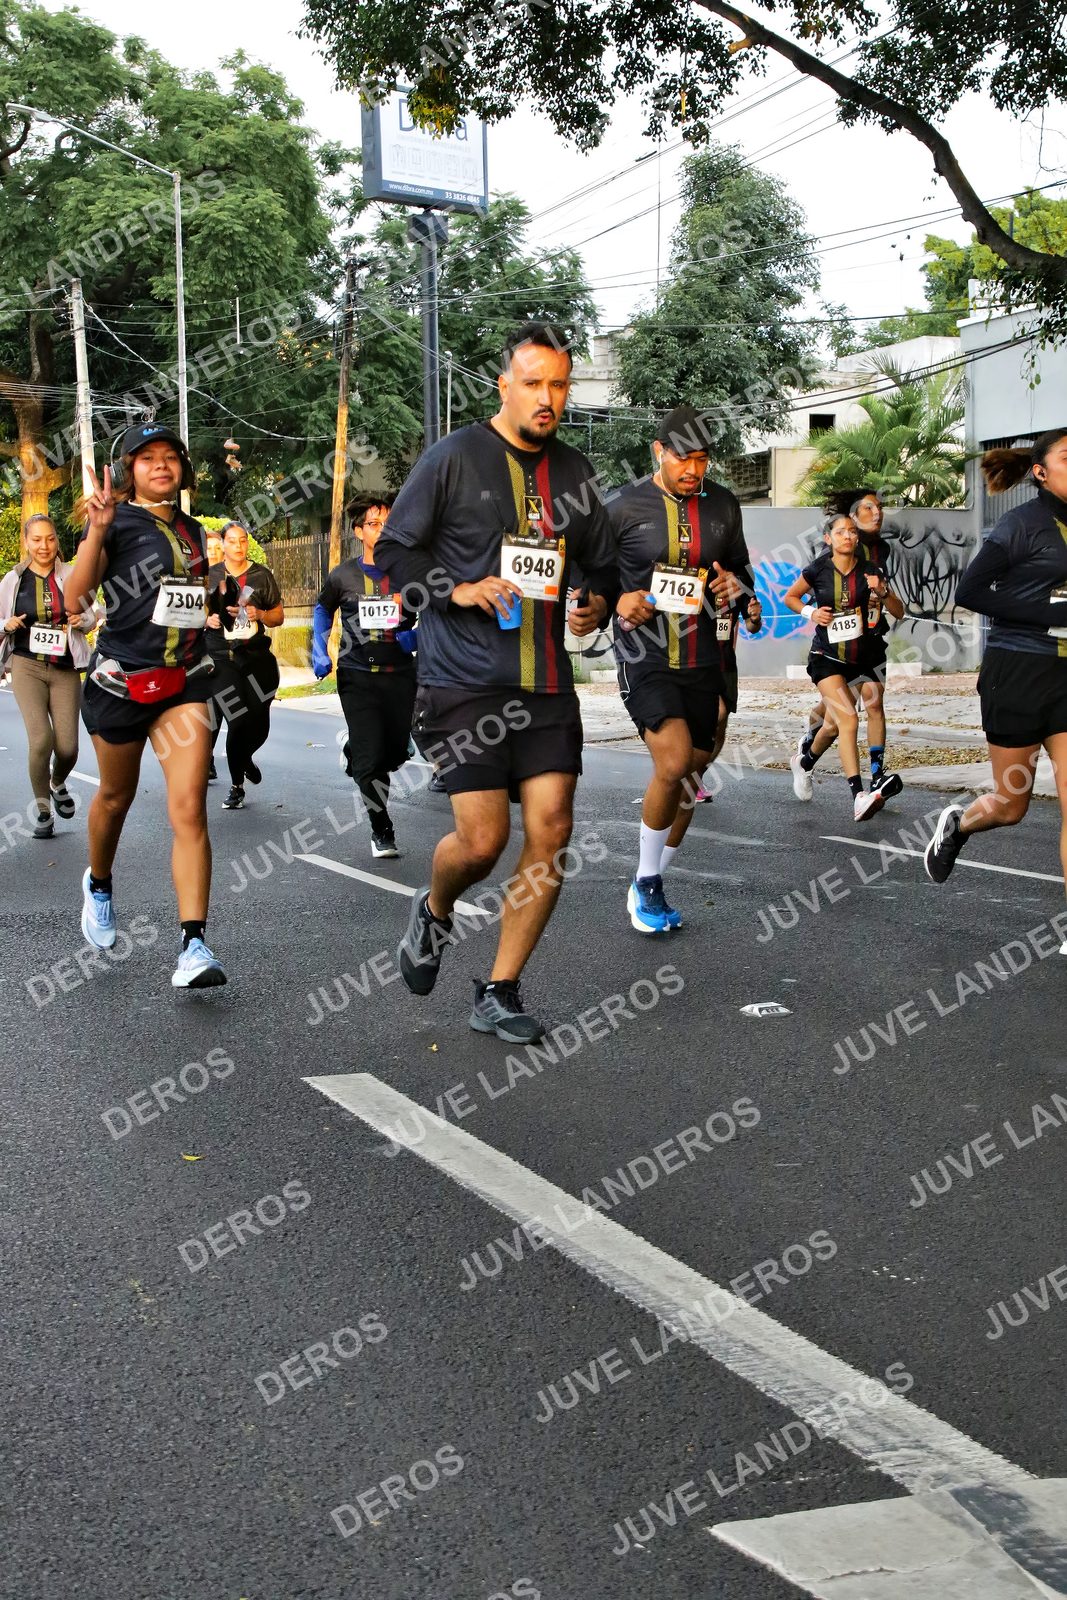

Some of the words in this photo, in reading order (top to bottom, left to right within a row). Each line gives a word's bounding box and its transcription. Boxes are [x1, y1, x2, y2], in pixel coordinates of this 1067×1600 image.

[512, 554, 555, 578] 6948
[659, 579, 695, 597] 7162
[166, 592, 204, 611] 7304
[361, 605, 396, 617] 10157
[832, 618, 857, 632] 4185
[34, 632, 60, 644] 4321
